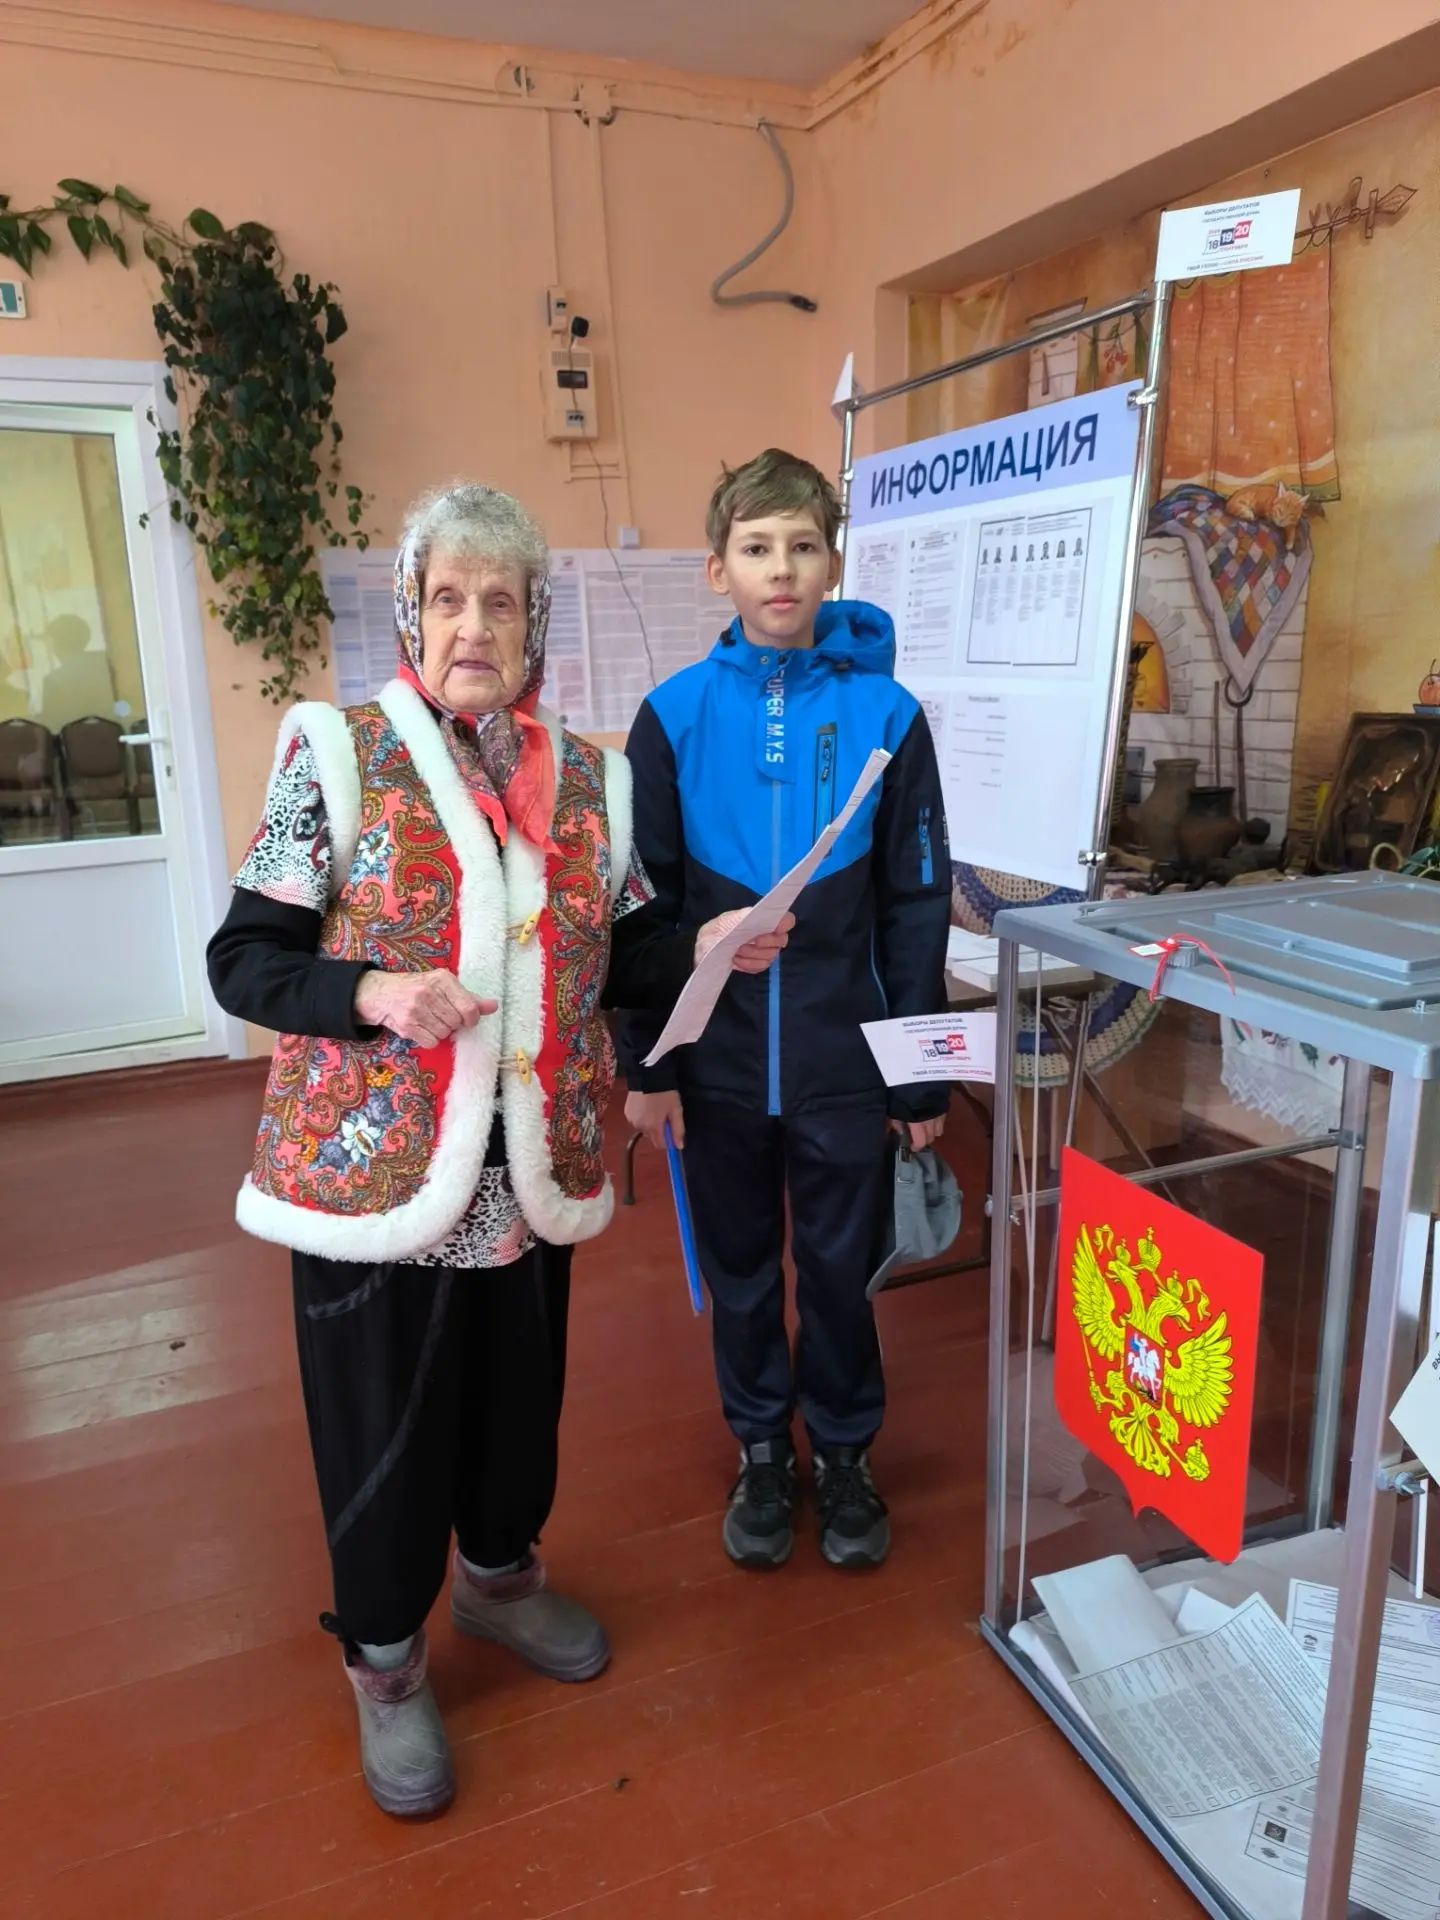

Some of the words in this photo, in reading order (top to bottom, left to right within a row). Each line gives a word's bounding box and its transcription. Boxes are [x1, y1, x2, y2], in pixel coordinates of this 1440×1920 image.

[1234, 223, 1250, 237] 20
[1221, 231, 1233, 243] 19
[1208, 239, 1219, 250] 18
[870, 413, 1099, 508] ИНФОРМАЦИЯ
[948, 1037, 963, 1048] 20
[924, 1048, 937, 1058] 18
